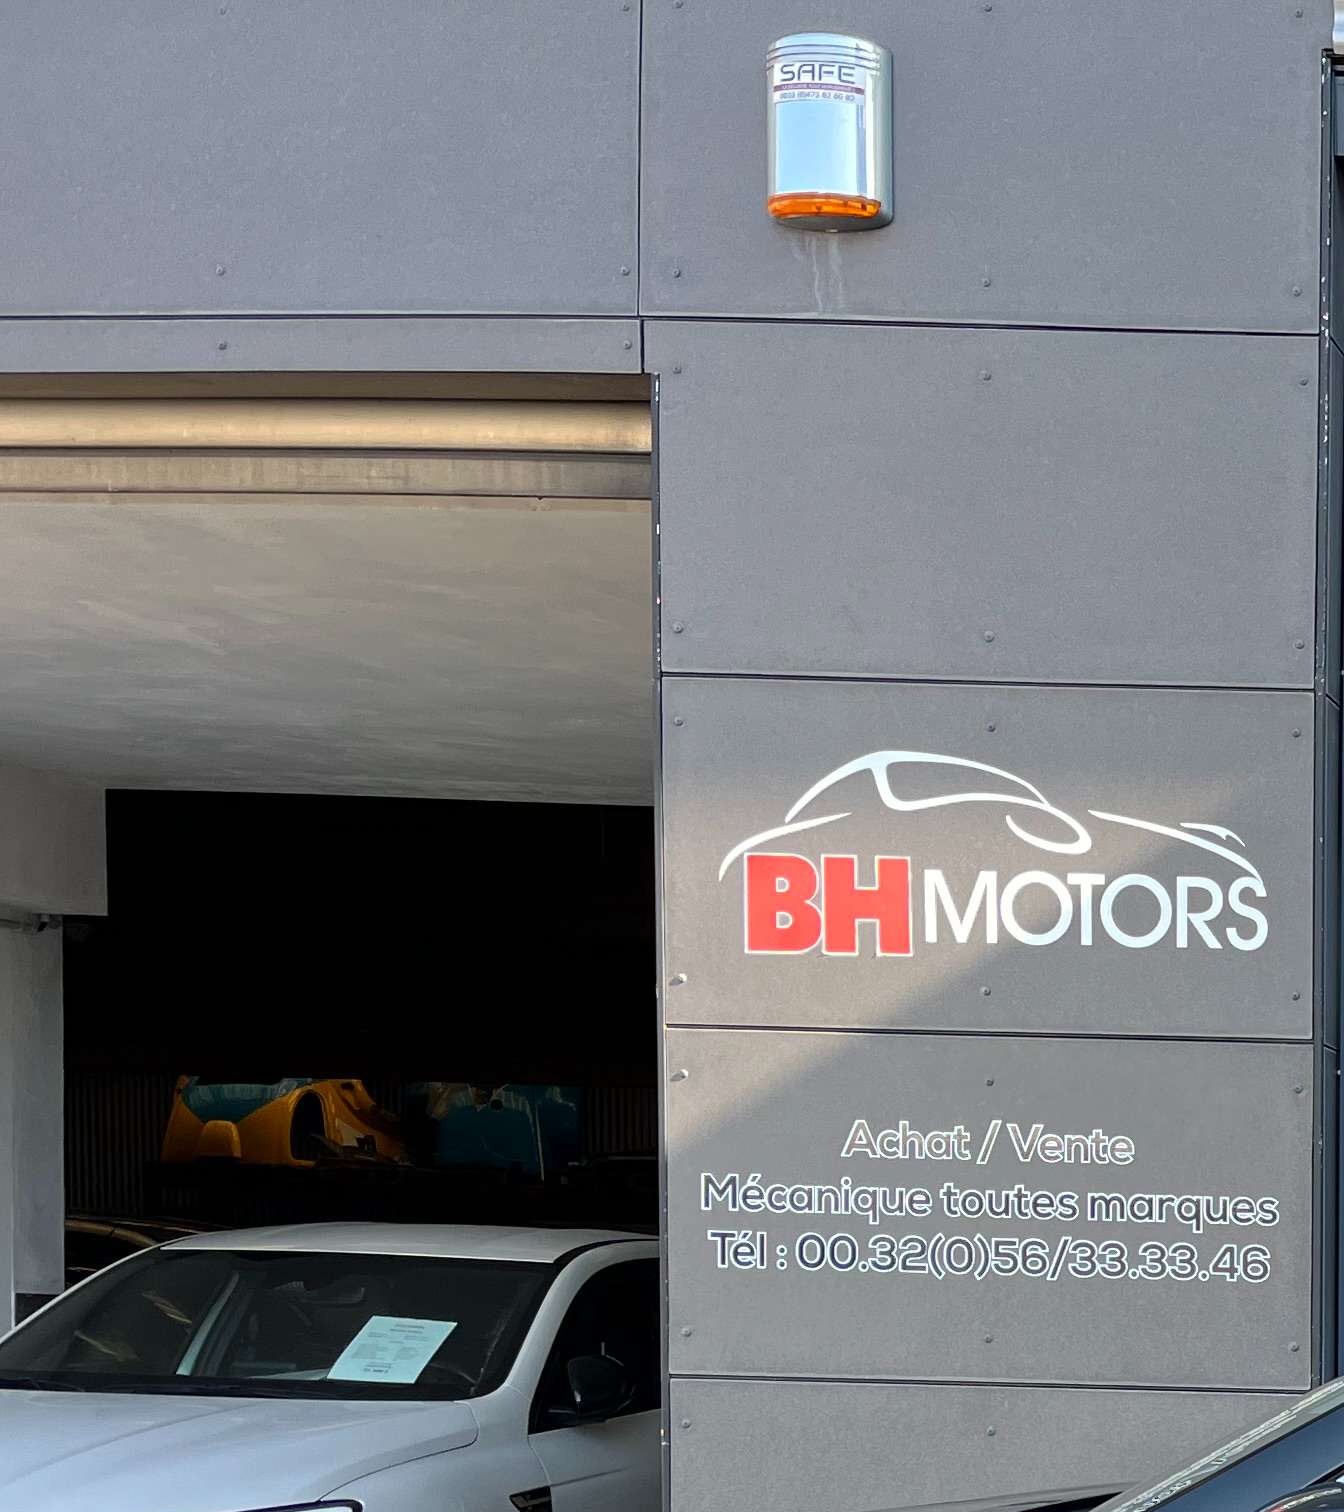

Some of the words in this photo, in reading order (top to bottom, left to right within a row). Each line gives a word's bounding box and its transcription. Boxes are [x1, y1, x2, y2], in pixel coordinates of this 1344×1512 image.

[780, 63, 856, 85] SAFE
[744, 852, 913, 957] BH
[923, 869, 1269, 952] MOTORS
[841, 1120, 971, 1160] Achat
[1007, 1123, 1136, 1165] Vente
[700, 1172, 933, 1225] Mécanique
[940, 1182, 1079, 1220] toutes
[1088, 1189, 1280, 1233] marques
[794, 1231, 1273, 1284] 00.32(0)56/33.33.46
